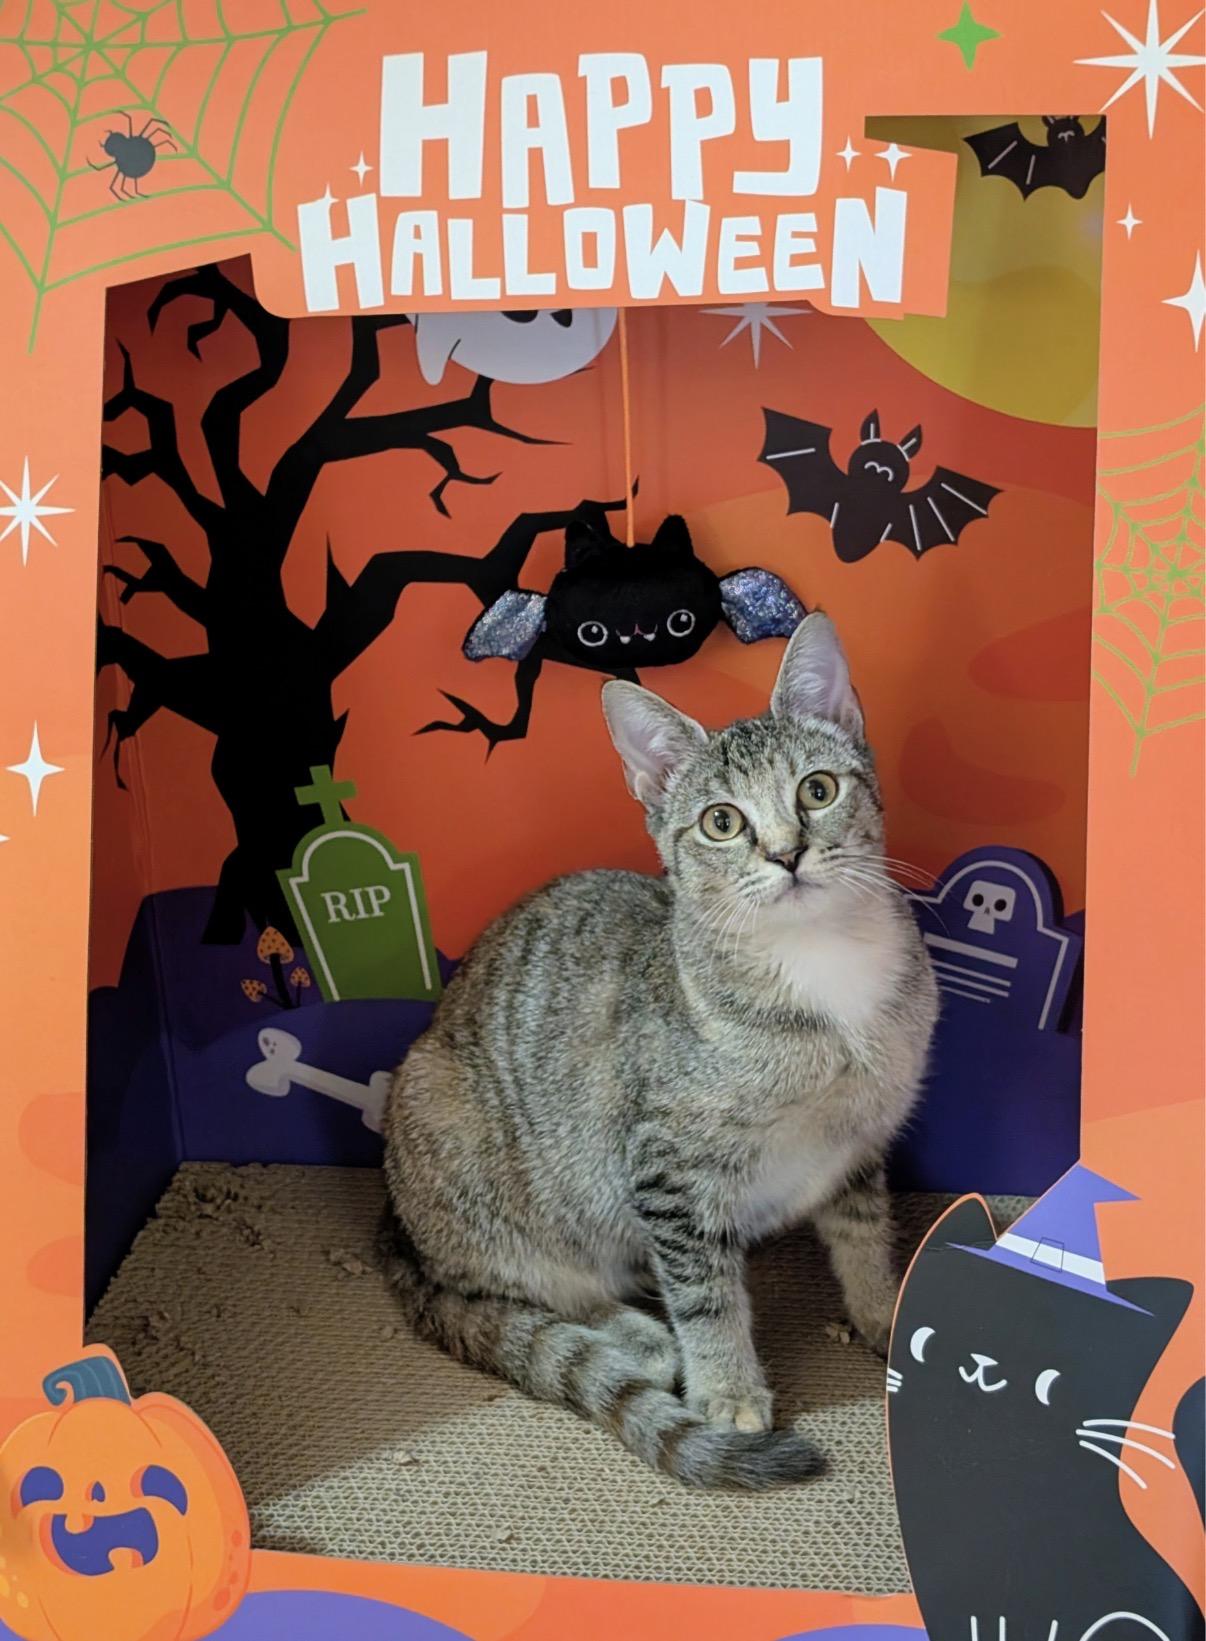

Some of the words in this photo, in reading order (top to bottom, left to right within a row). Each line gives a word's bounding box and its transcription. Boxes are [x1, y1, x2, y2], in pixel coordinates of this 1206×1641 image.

[379, 50, 823, 209] HAPPY
[297, 186, 907, 313] HALLOWEEN
[320, 885, 391, 923] RIP
